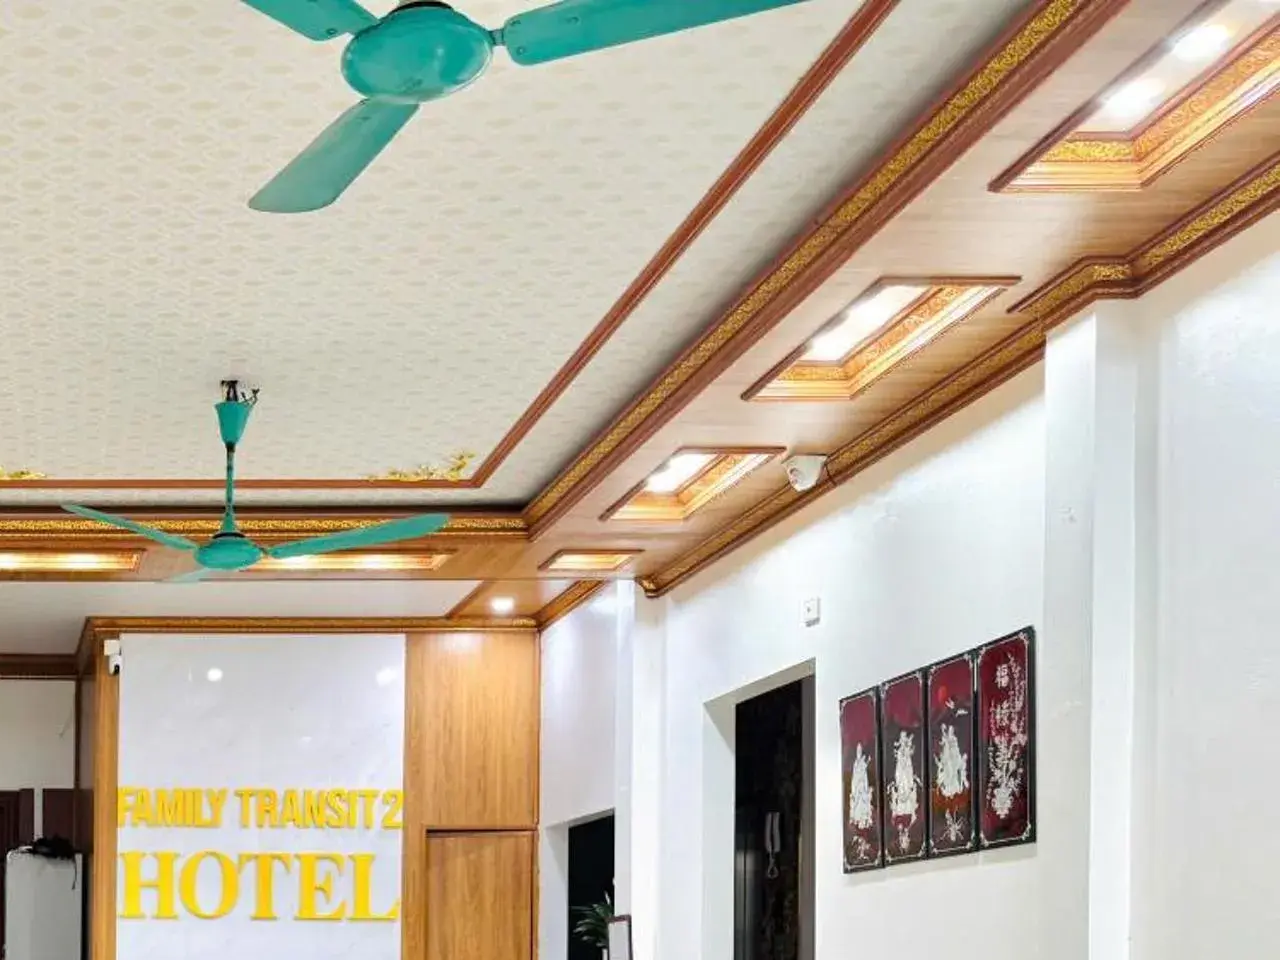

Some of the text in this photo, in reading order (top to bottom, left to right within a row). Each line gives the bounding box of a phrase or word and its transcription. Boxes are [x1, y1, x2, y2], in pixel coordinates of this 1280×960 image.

[118, 787, 404, 829] FAMILY TRANSIT 2
[118, 849, 401, 921] HOTEL
